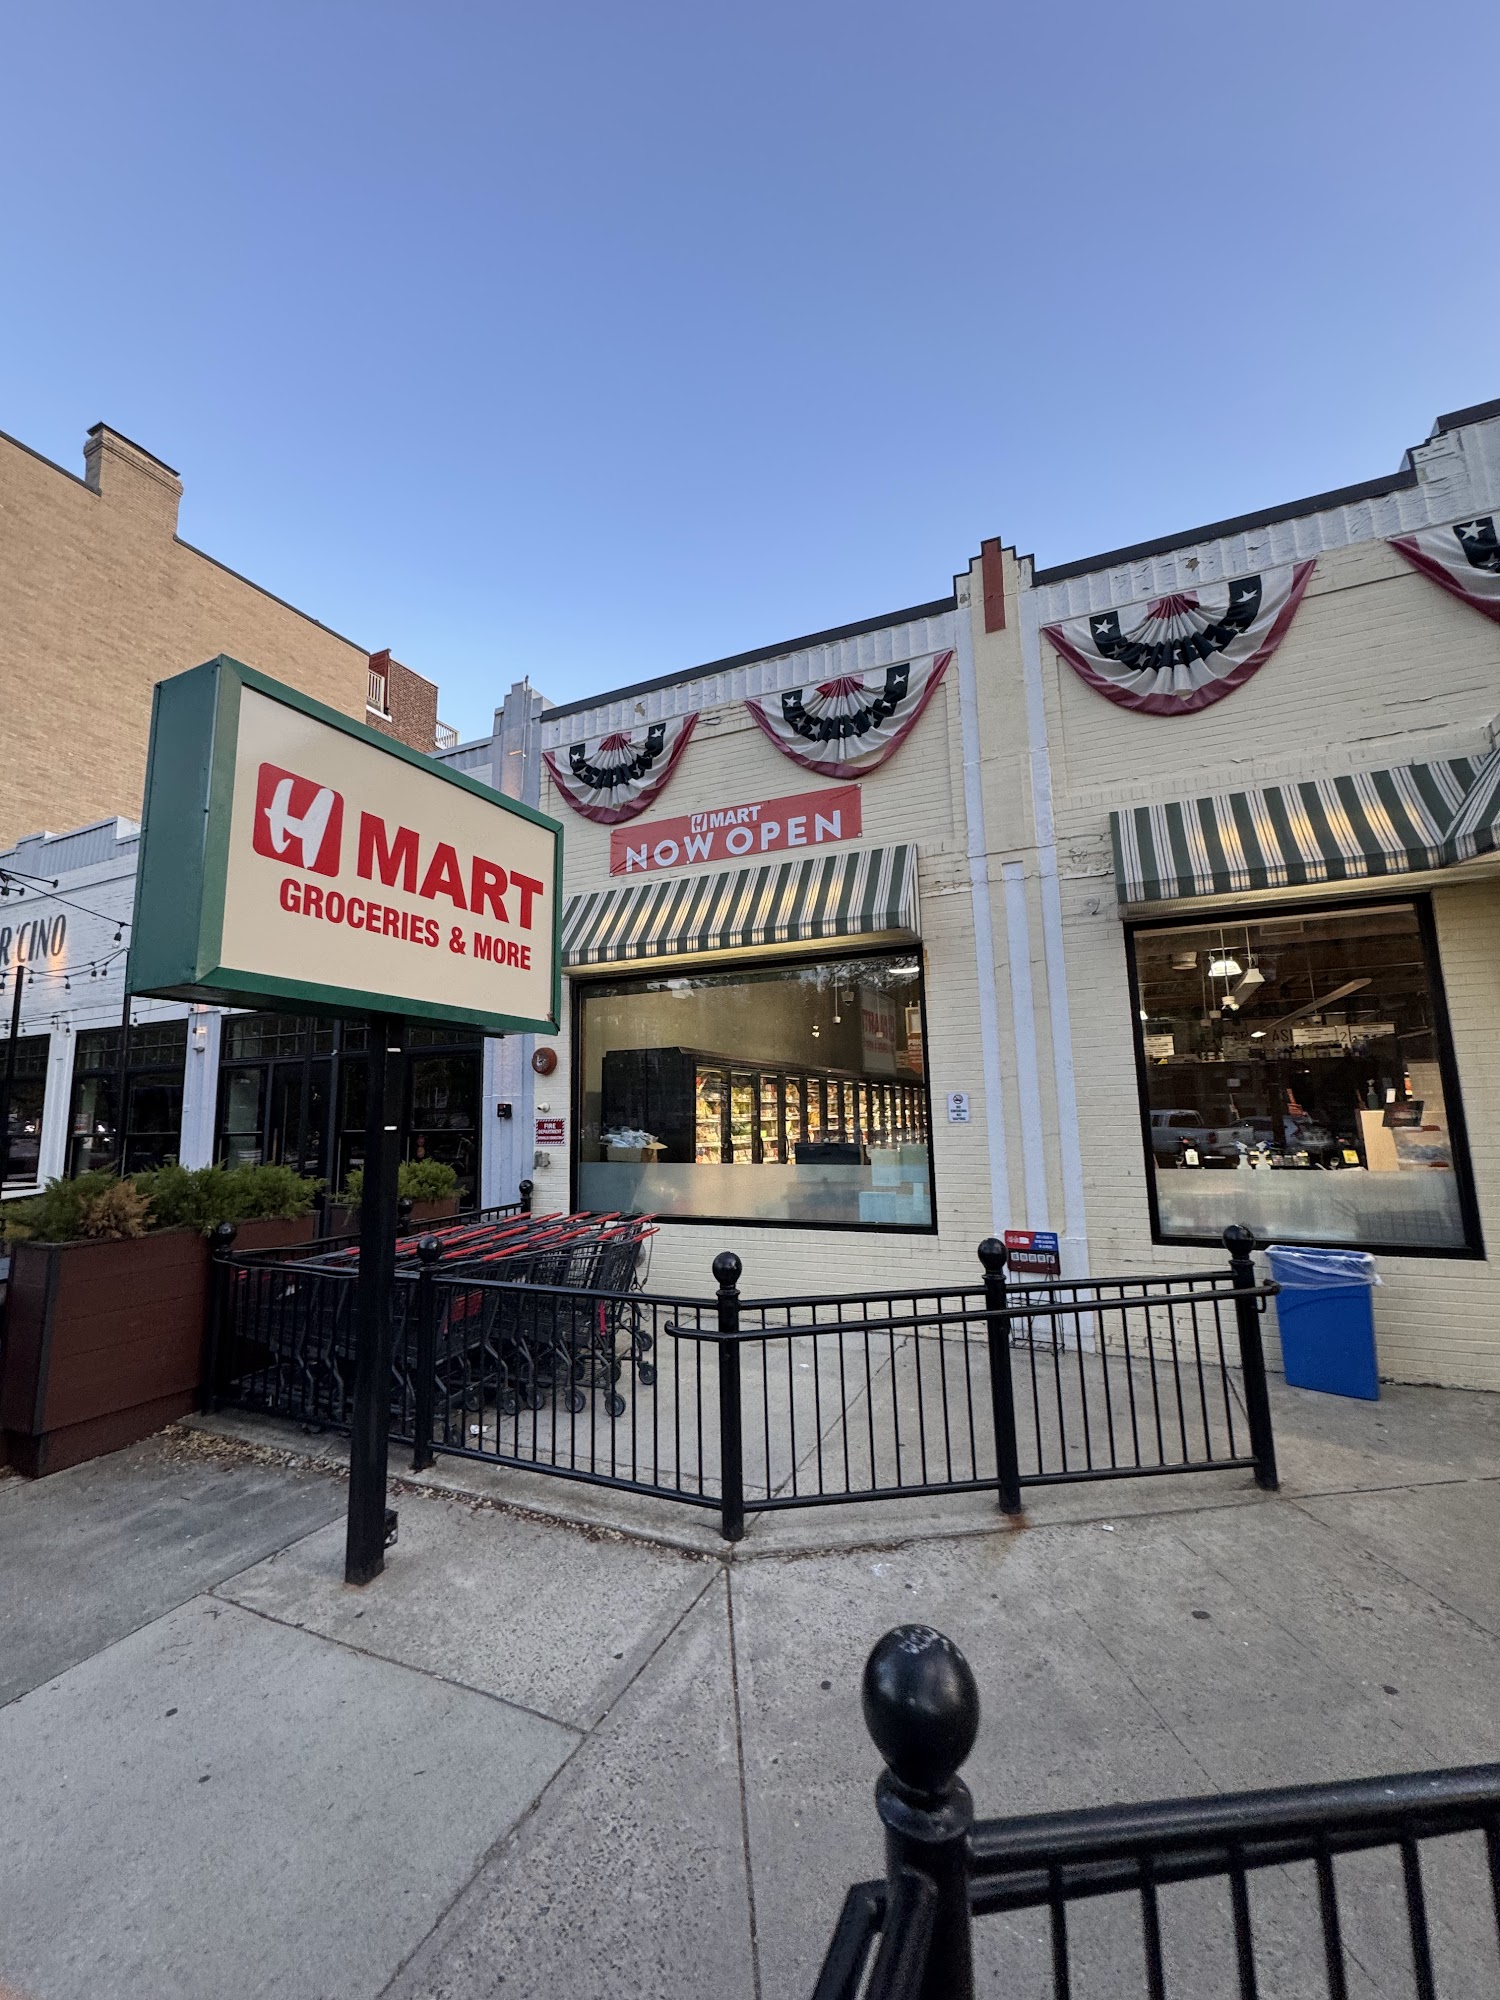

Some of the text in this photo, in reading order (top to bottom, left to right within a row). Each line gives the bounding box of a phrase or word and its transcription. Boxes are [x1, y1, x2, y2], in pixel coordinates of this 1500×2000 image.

[263, 778, 544, 930] H MART
[625, 810, 842, 872] NOW OPEN
[710, 805, 761, 828] MART
[279, 878, 531, 971] GROCERIES & MORE
